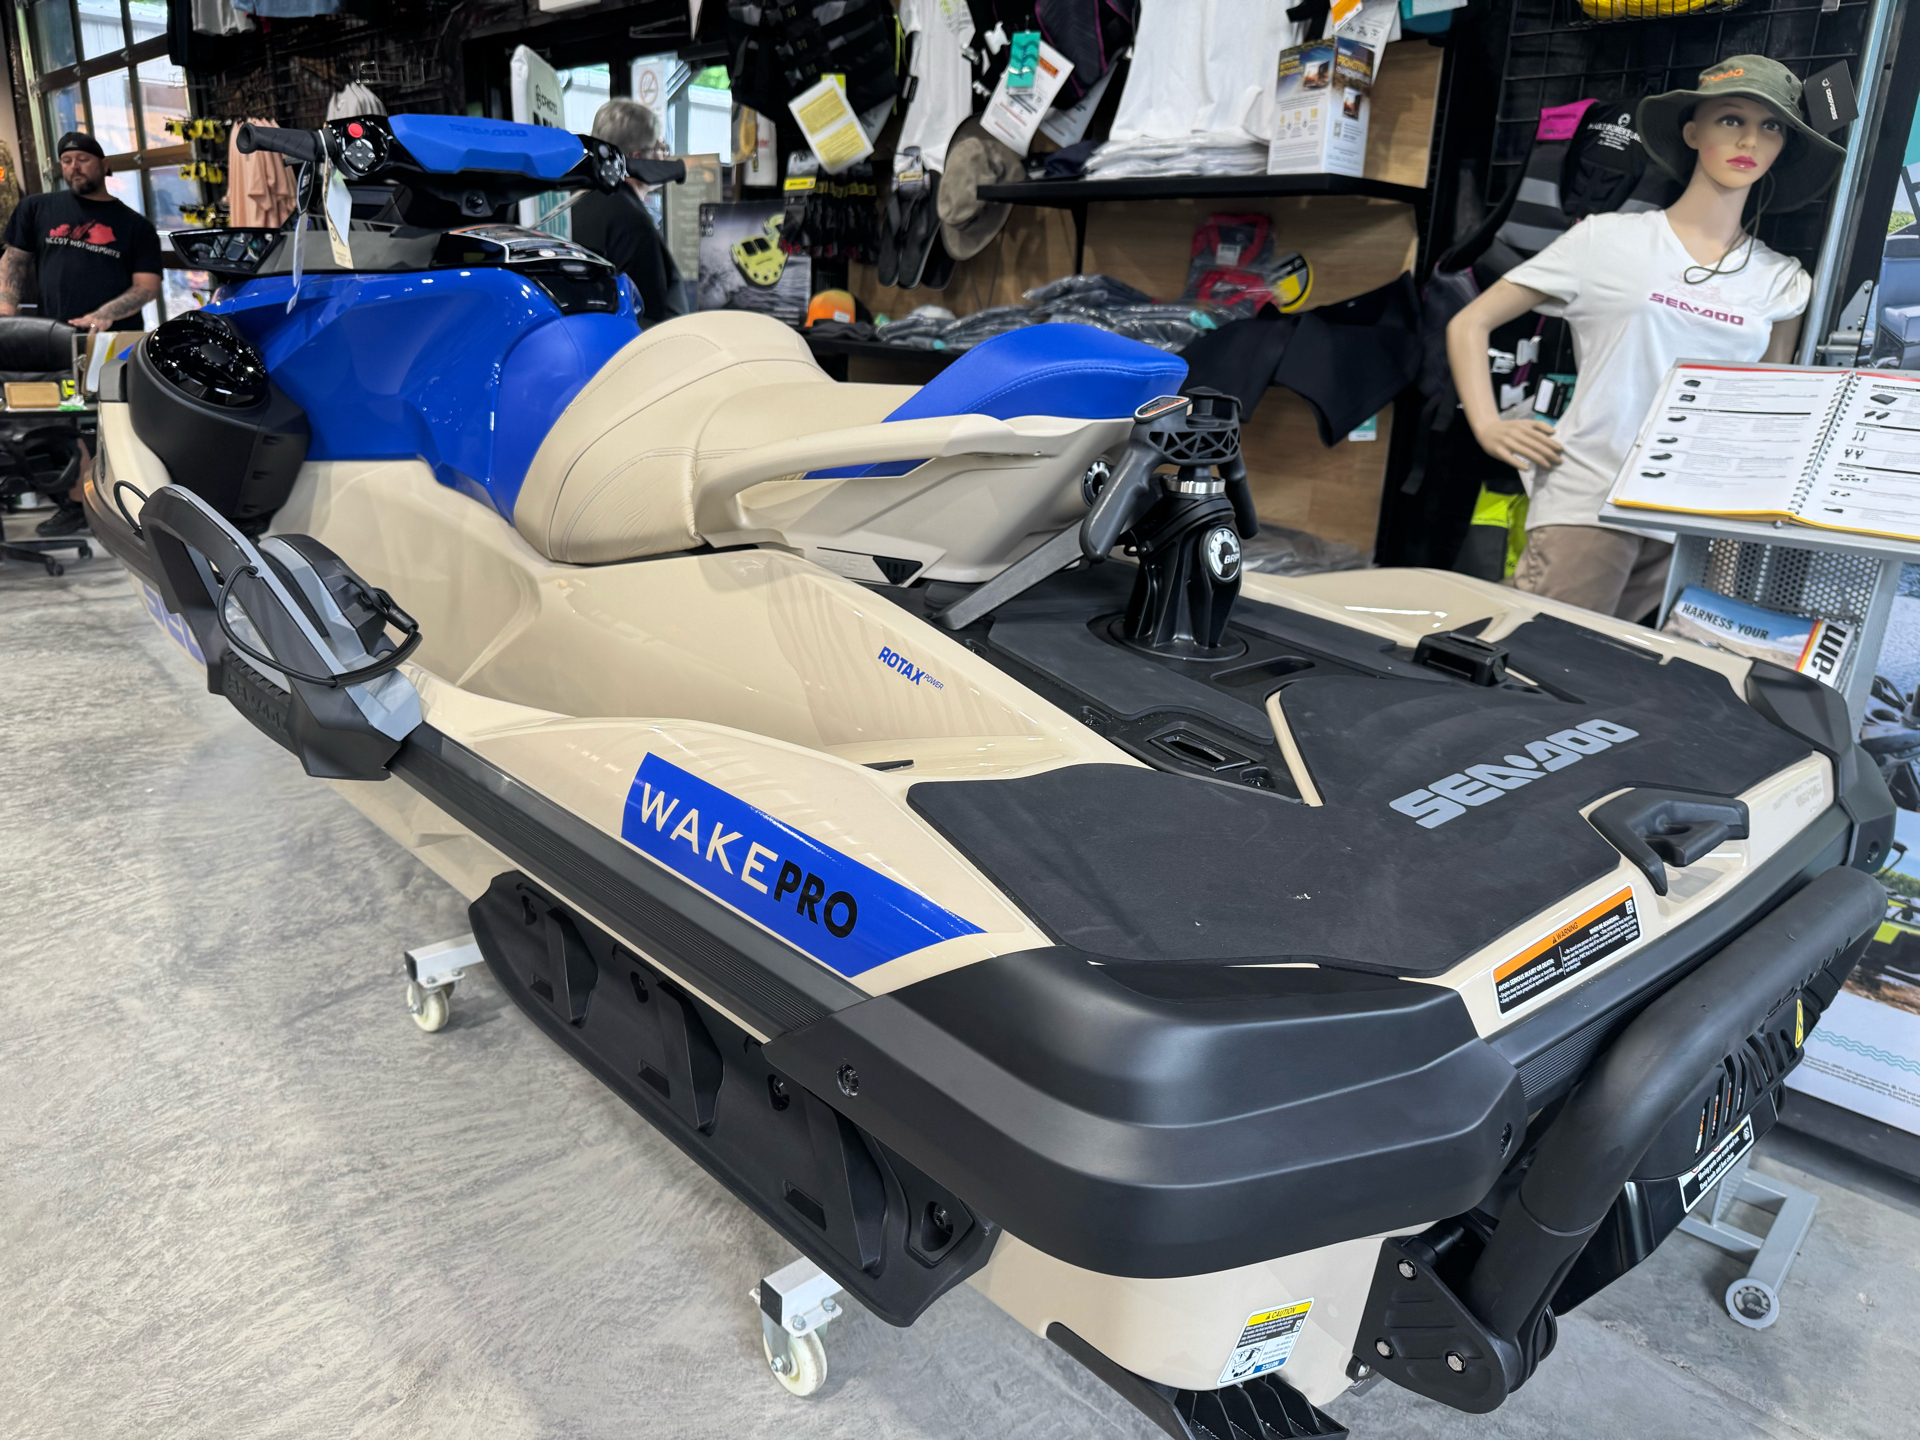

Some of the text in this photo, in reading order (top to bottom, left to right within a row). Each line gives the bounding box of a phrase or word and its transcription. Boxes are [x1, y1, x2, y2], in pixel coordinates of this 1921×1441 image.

[1224, 554, 1241, 564] BRP
[1682, 603, 1770, 640] HARNESS YOUR
[878, 646, 944, 690] ROTAX POWER
[640, 782, 859, 938] WAKE PRO
[1556, 922, 1578, 940] WARNING
[1272, 1307, 1296, 1319] CAUTION
